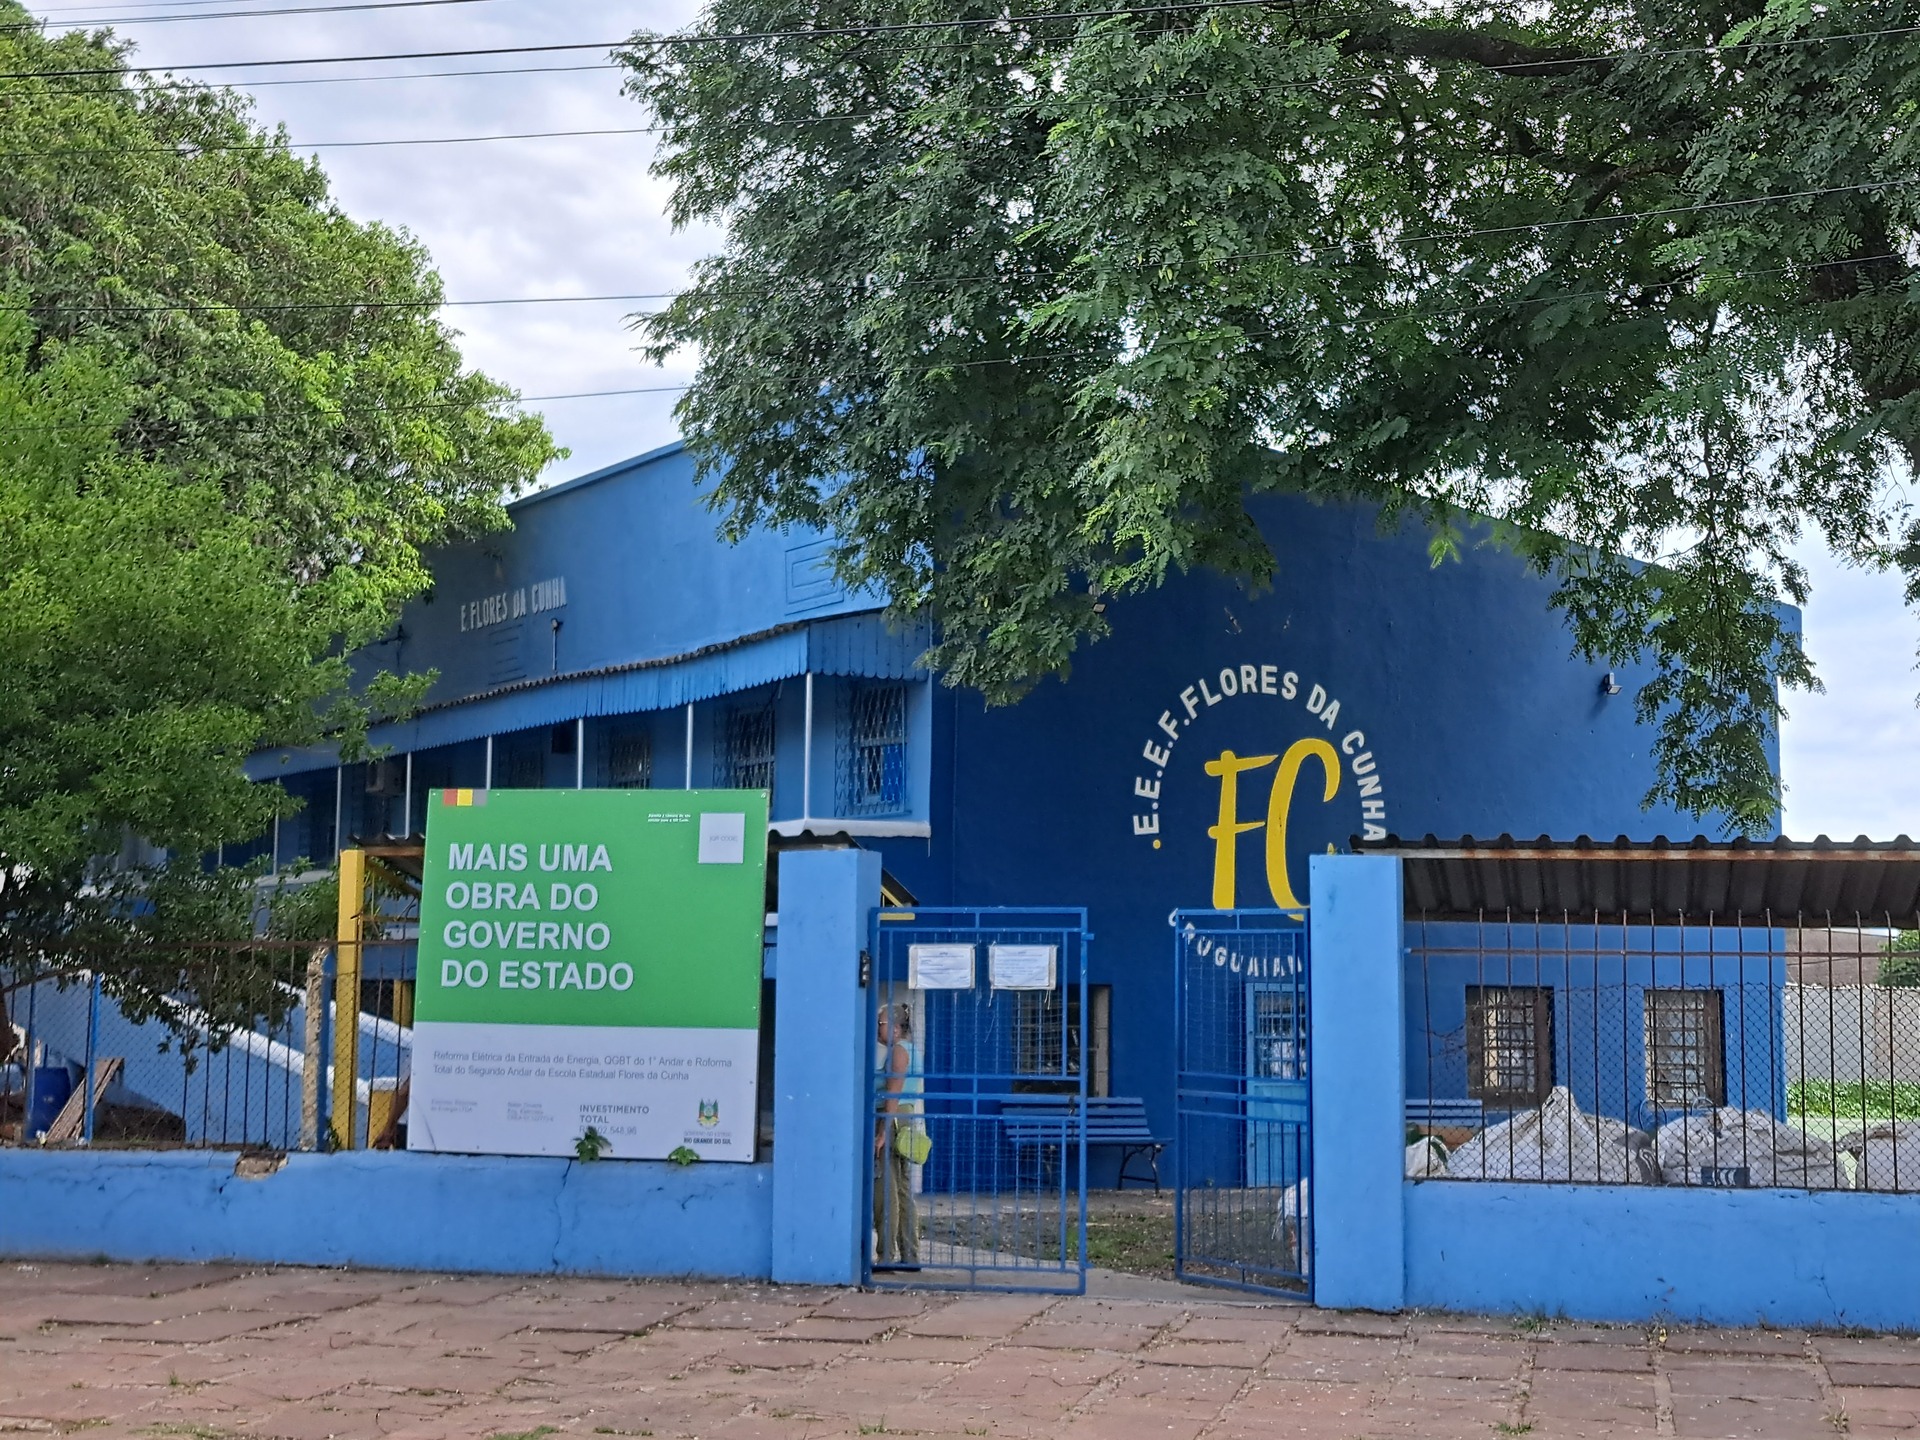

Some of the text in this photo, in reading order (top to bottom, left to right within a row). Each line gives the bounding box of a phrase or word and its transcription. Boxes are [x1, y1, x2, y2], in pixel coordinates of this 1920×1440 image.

[513, 587, 527, 619] DA
[531, 575, 568, 614] CUNHA
[1306, 683, 1342, 731] DA
[1341, 730, 1387, 841] CUNHA
[448, 843, 613, 872] MAIS UMA
[445, 881, 599, 912] OBRA DO
[443, 921, 611, 951] GOVERNO
[441, 960, 635, 991] DO ESTADO
[433, 1064, 453, 1074] Total
[468, 1066, 505, 1078] Segundo
[507, 1067, 532, 1076] Andar
[548, 1068, 576, 1078] Escola
[579, 1069, 616, 1079] Estadual
[618, 1070, 645, 1080] Flores
[647, 1071, 658, 1080] da
[660, 1071, 689, 1081] Cunha
[472, 1052, 503, 1062] Elétrica
[505, 1053, 515, 1062] da
[518, 1053, 551, 1063] Entrada
[634, 1056, 645, 1065] do
[658, 1057, 684, 1067] Andar
[686, 1059, 693, 1067] e
[579, 1105, 650, 1114] INVESTIMENTO
[579, 1115, 609, 1124] TOTAL
